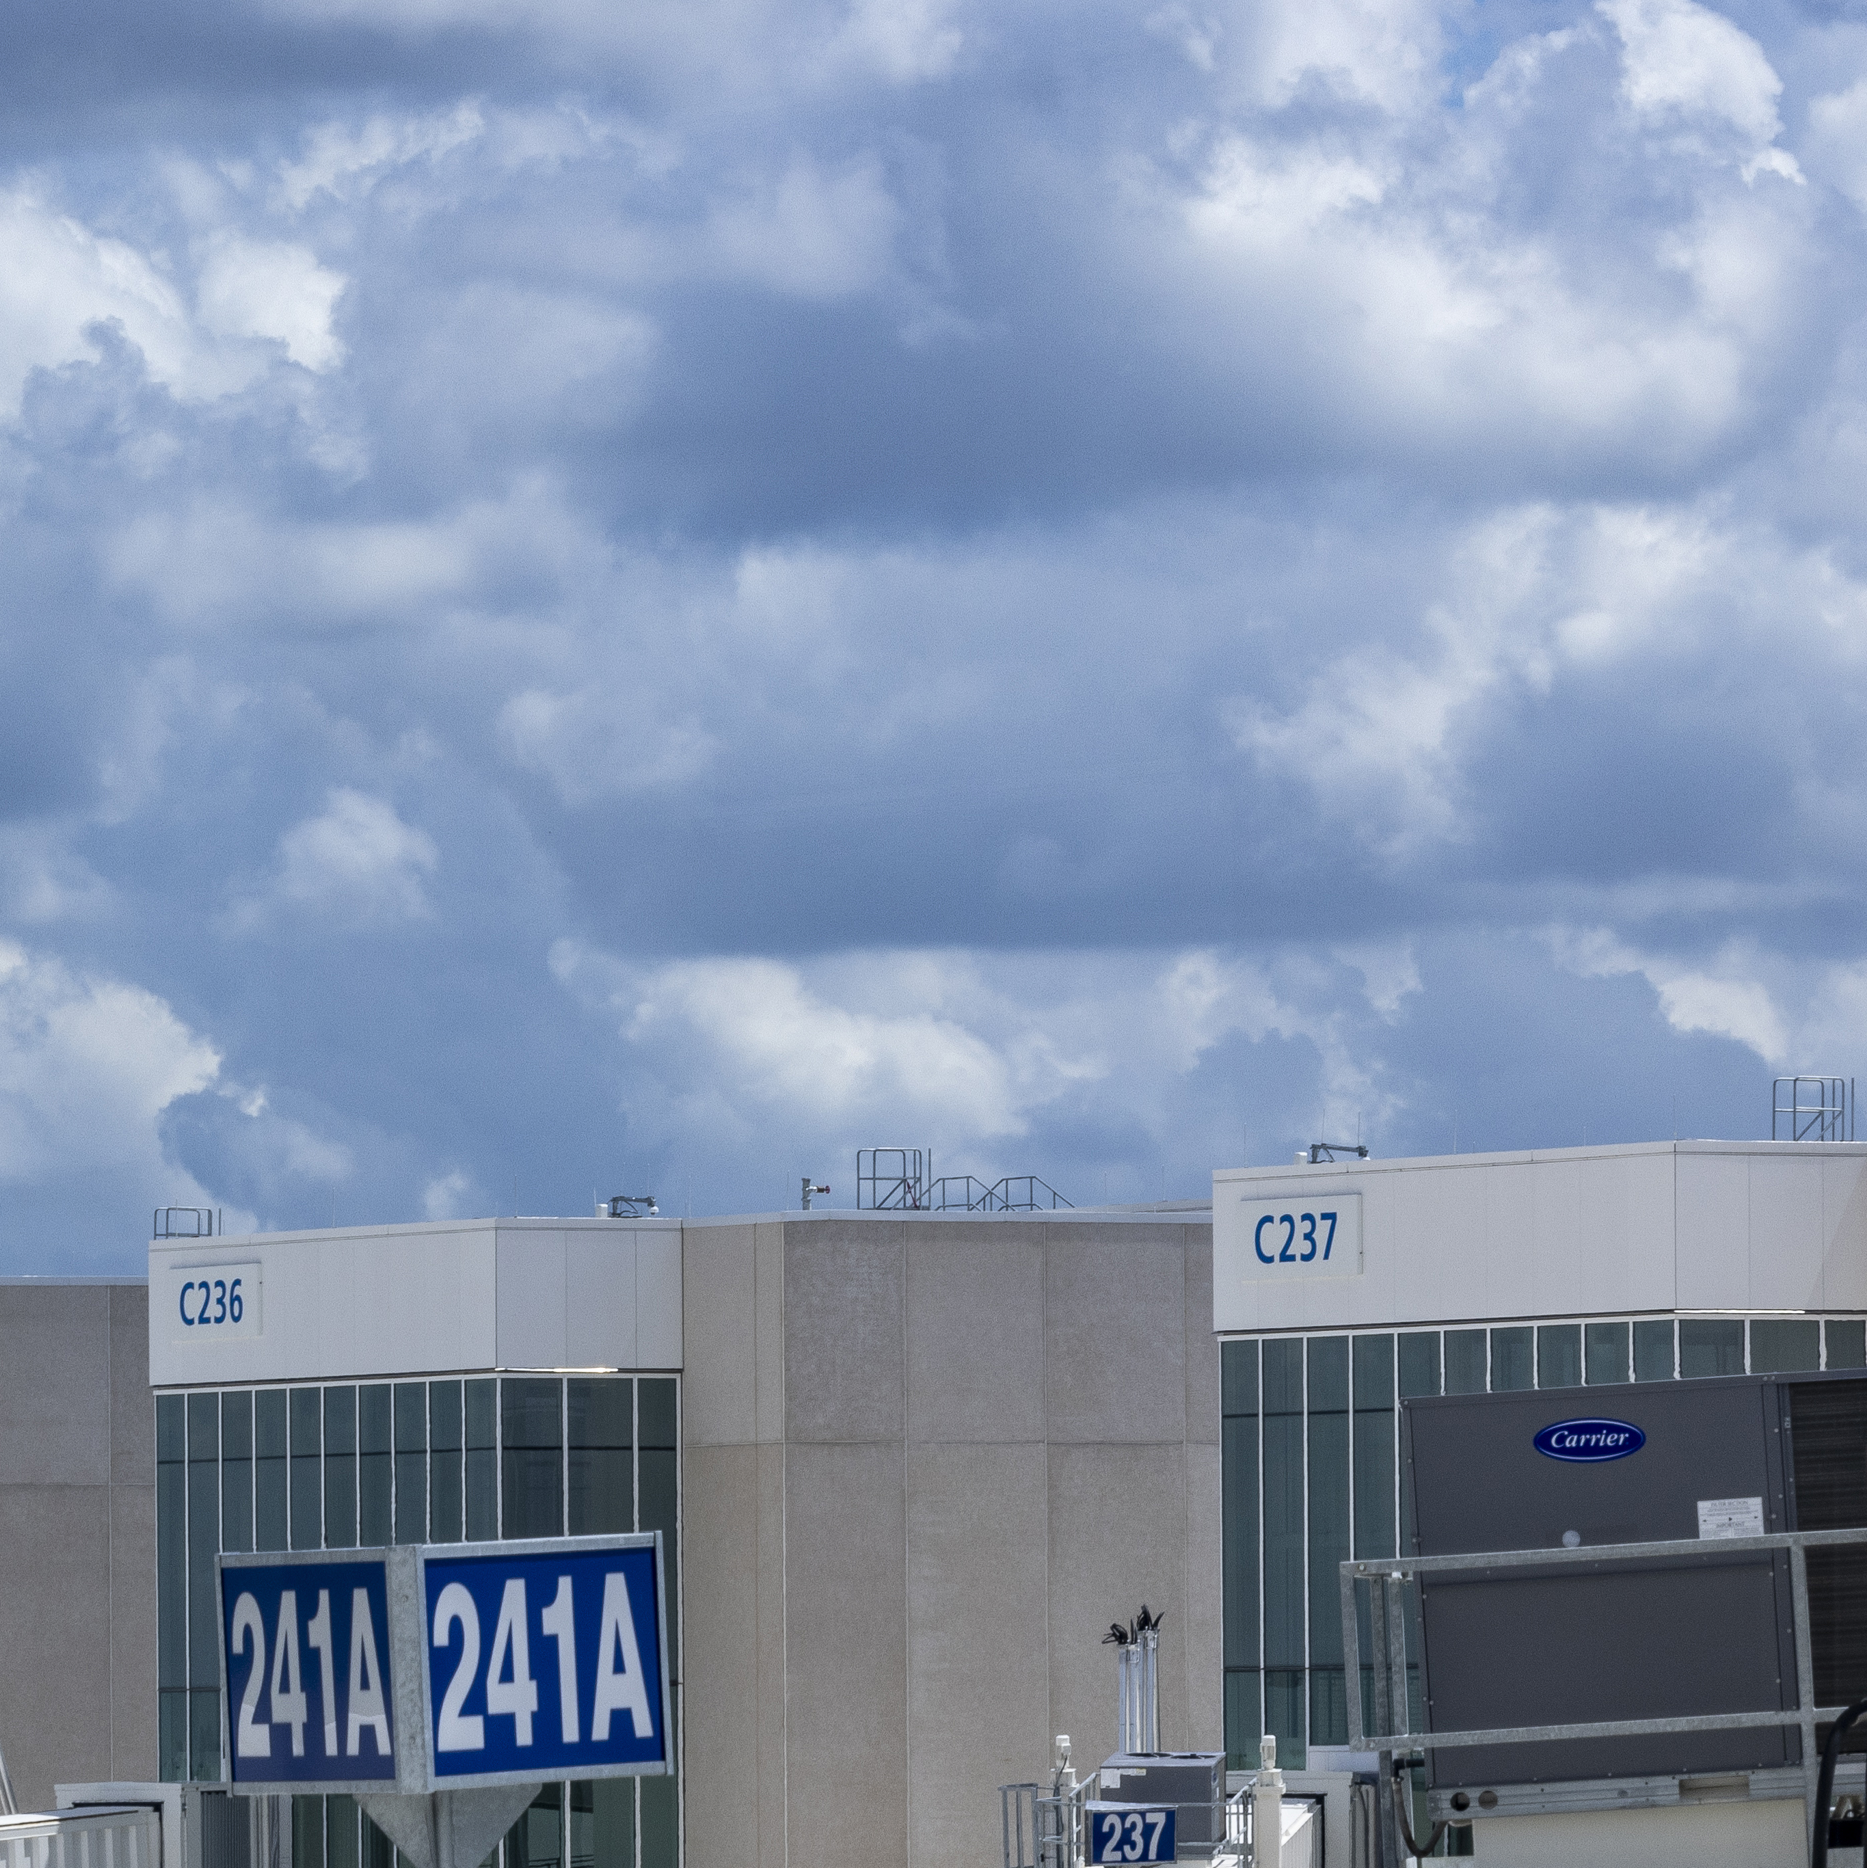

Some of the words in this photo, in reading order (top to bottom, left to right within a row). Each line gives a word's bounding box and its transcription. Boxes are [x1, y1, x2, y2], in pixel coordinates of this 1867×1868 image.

[1254, 1211, 1338, 1264] C237
[179, 1278, 243, 1326] C236
[1550, 1429, 1629, 1448] Carrier
[231, 1587, 392, 1758] 241A
[432, 1571, 654, 1753] 241A
[1101, 1811, 1166, 1862] 237
